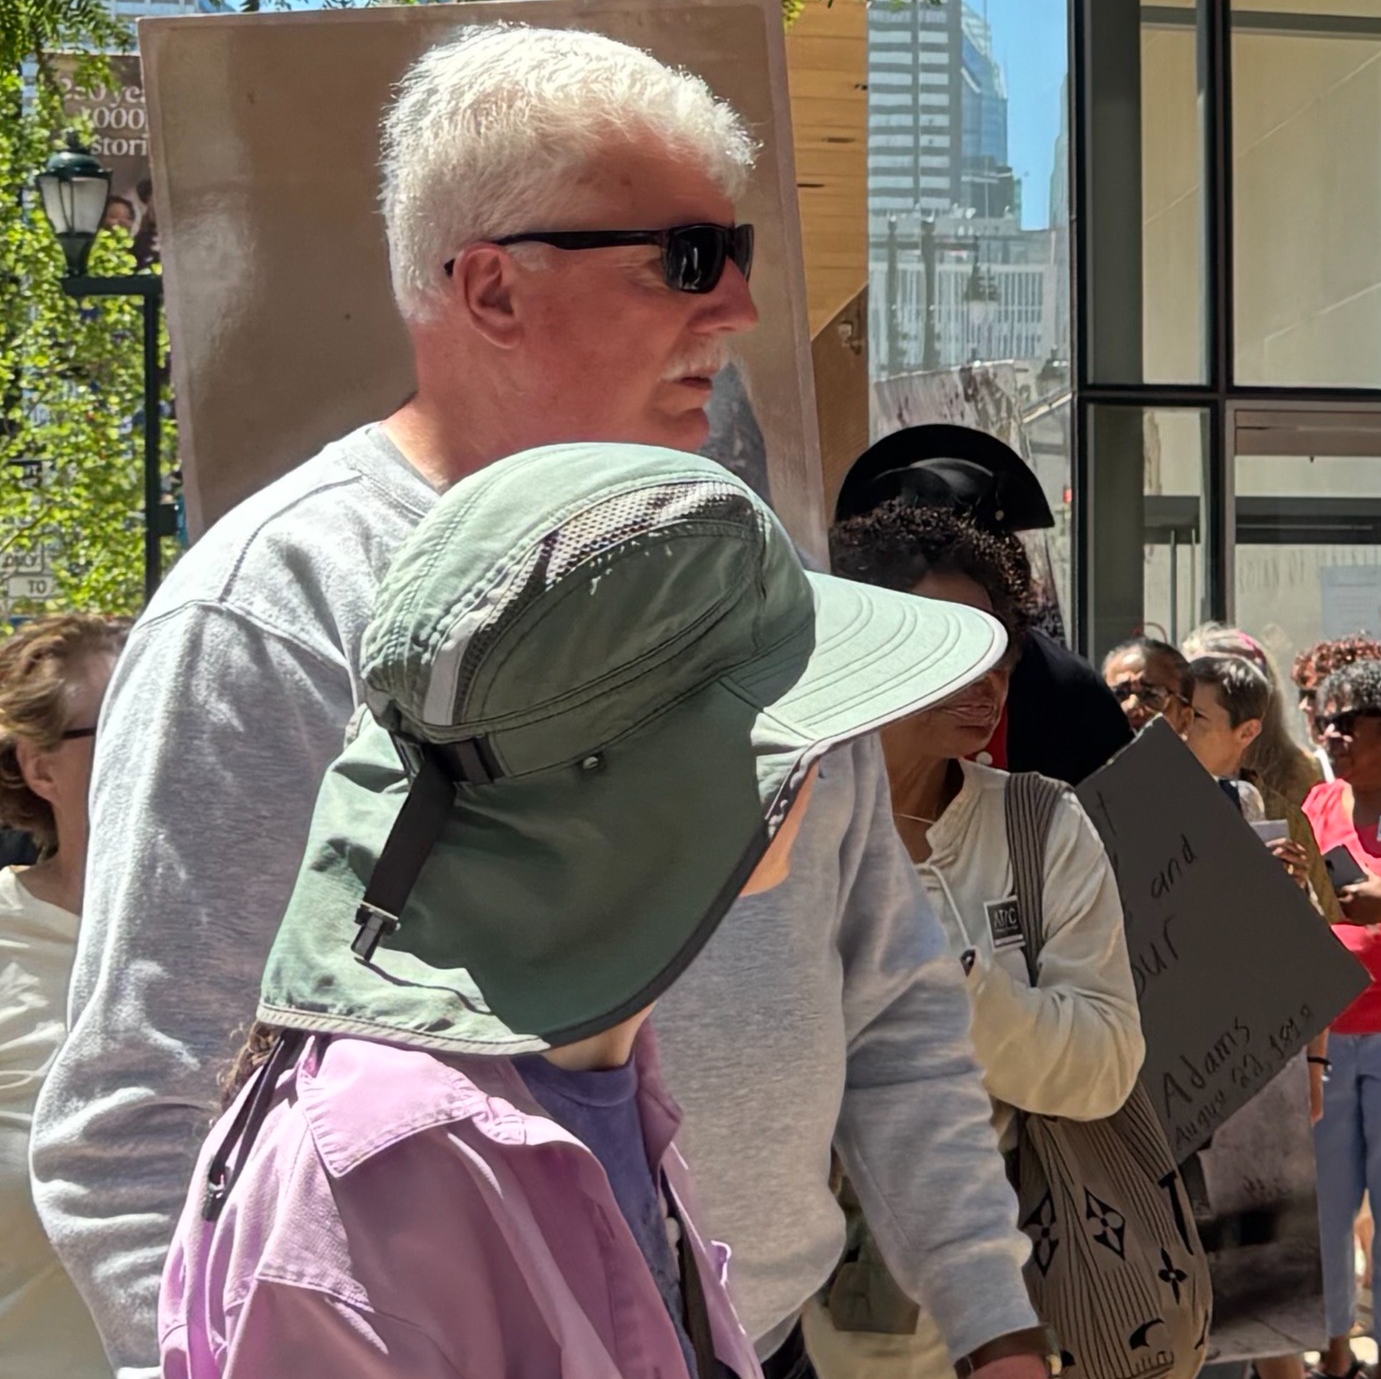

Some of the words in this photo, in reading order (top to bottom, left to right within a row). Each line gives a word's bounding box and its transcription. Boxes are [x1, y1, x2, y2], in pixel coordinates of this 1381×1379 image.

[82, 106, 146, 130] 000
[110, 85, 145, 108] ye
[1150, 833, 1197, 900] and
[1161, 1017, 1253, 1119] Adams
